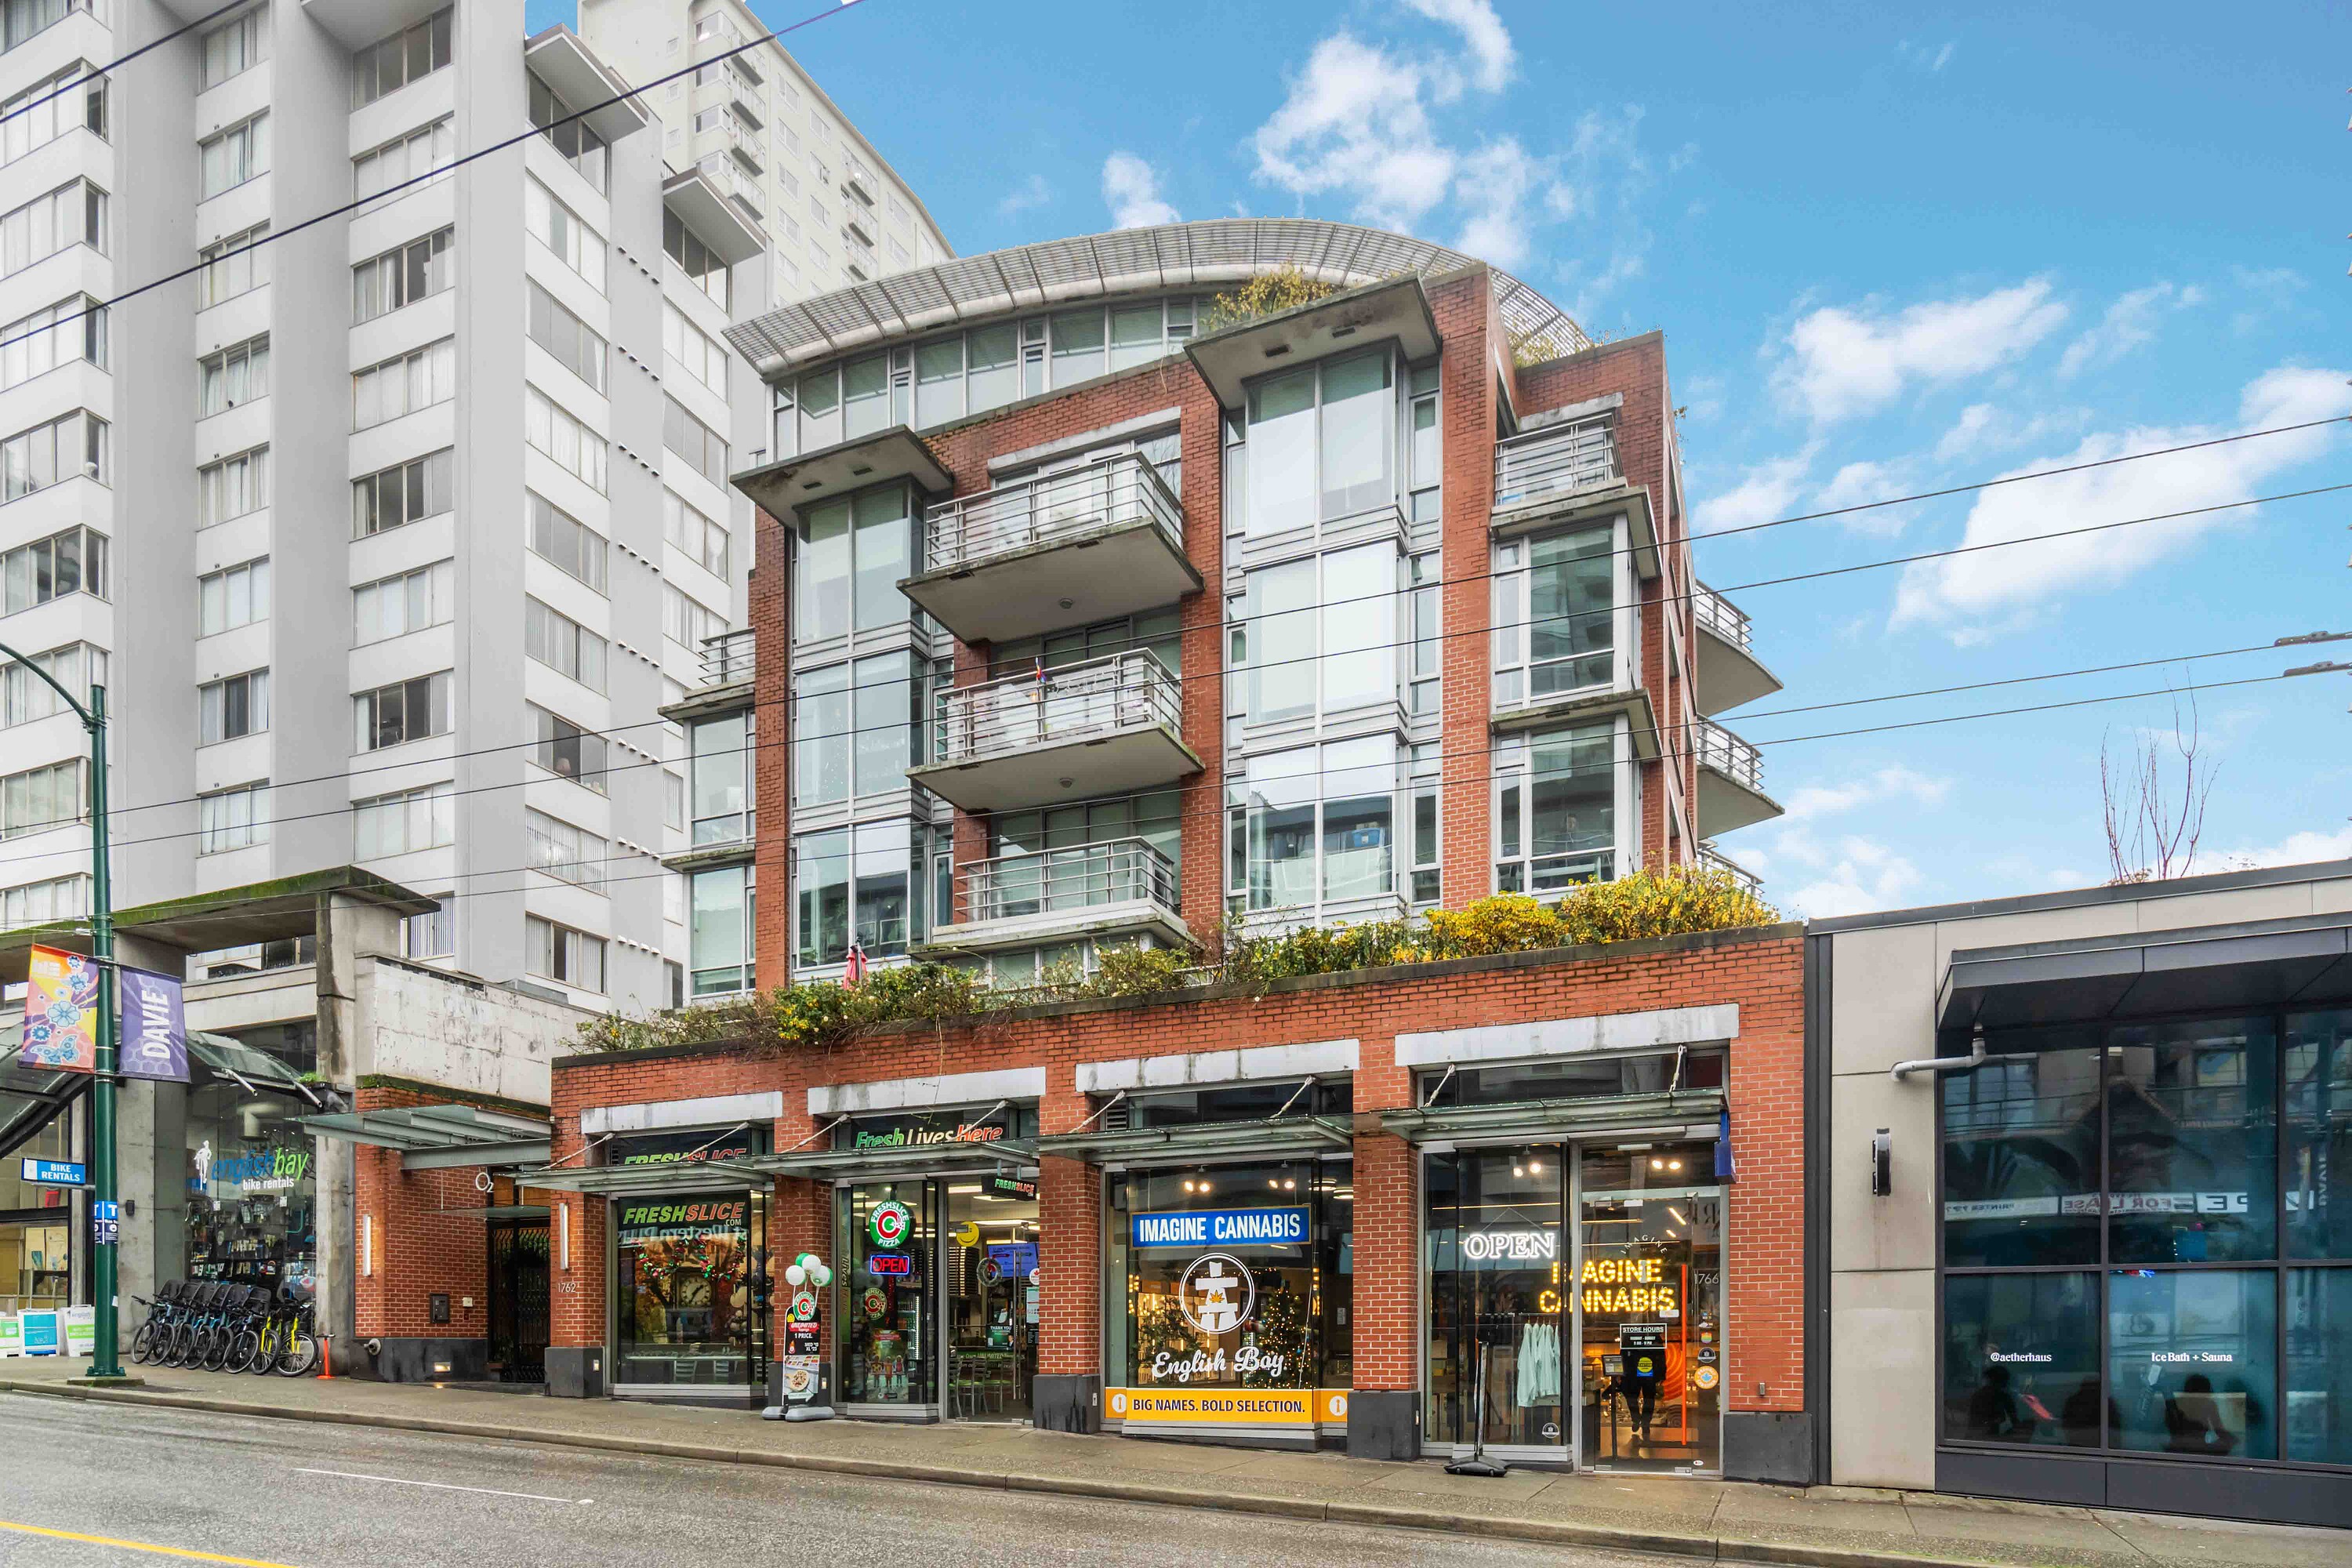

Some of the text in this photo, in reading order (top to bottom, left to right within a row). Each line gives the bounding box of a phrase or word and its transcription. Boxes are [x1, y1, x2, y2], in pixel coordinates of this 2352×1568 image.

[141, 989, 171, 1059] DAVIE
[855, 1124, 1003, 1148] Fresh Lives Here
[50, 1163, 71, 1172] BIKE
[41, 1171, 80, 1181] RENTALS
[243, 1176, 295, 1190] bike rentals
[994, 1178, 1035, 1193] FRESHSLICE
[622, 1203, 745, 1225] FRESHSLICE
[870, 1201, 909, 1223] FRESHSLICE
[1139, 1214, 1301, 1242] IMAGINE CANNABIS
[877, 1238, 900, 1247] PIZZA
[1465, 1232, 1555, 1259] OPEN
[1621, 1234, 1668, 1254] IMAGINE
[873, 1258, 908, 1272] OPEN
[1694, 1273, 1719, 1285] 1766
[557, 1283, 576, 1293] 1762
[1152, 1346, 1284, 1382] English Bay
[1990, 1352, 2052, 1362] @aetherhaus
[2151, 1352, 2166, 1362] Ice
[2167, 1352, 2190, 1362] Bath
[2201, 1352, 2233, 1362] Sauna
[1133, 1399, 1305, 1413] BIG NAMES. BOLD SELECTION.
